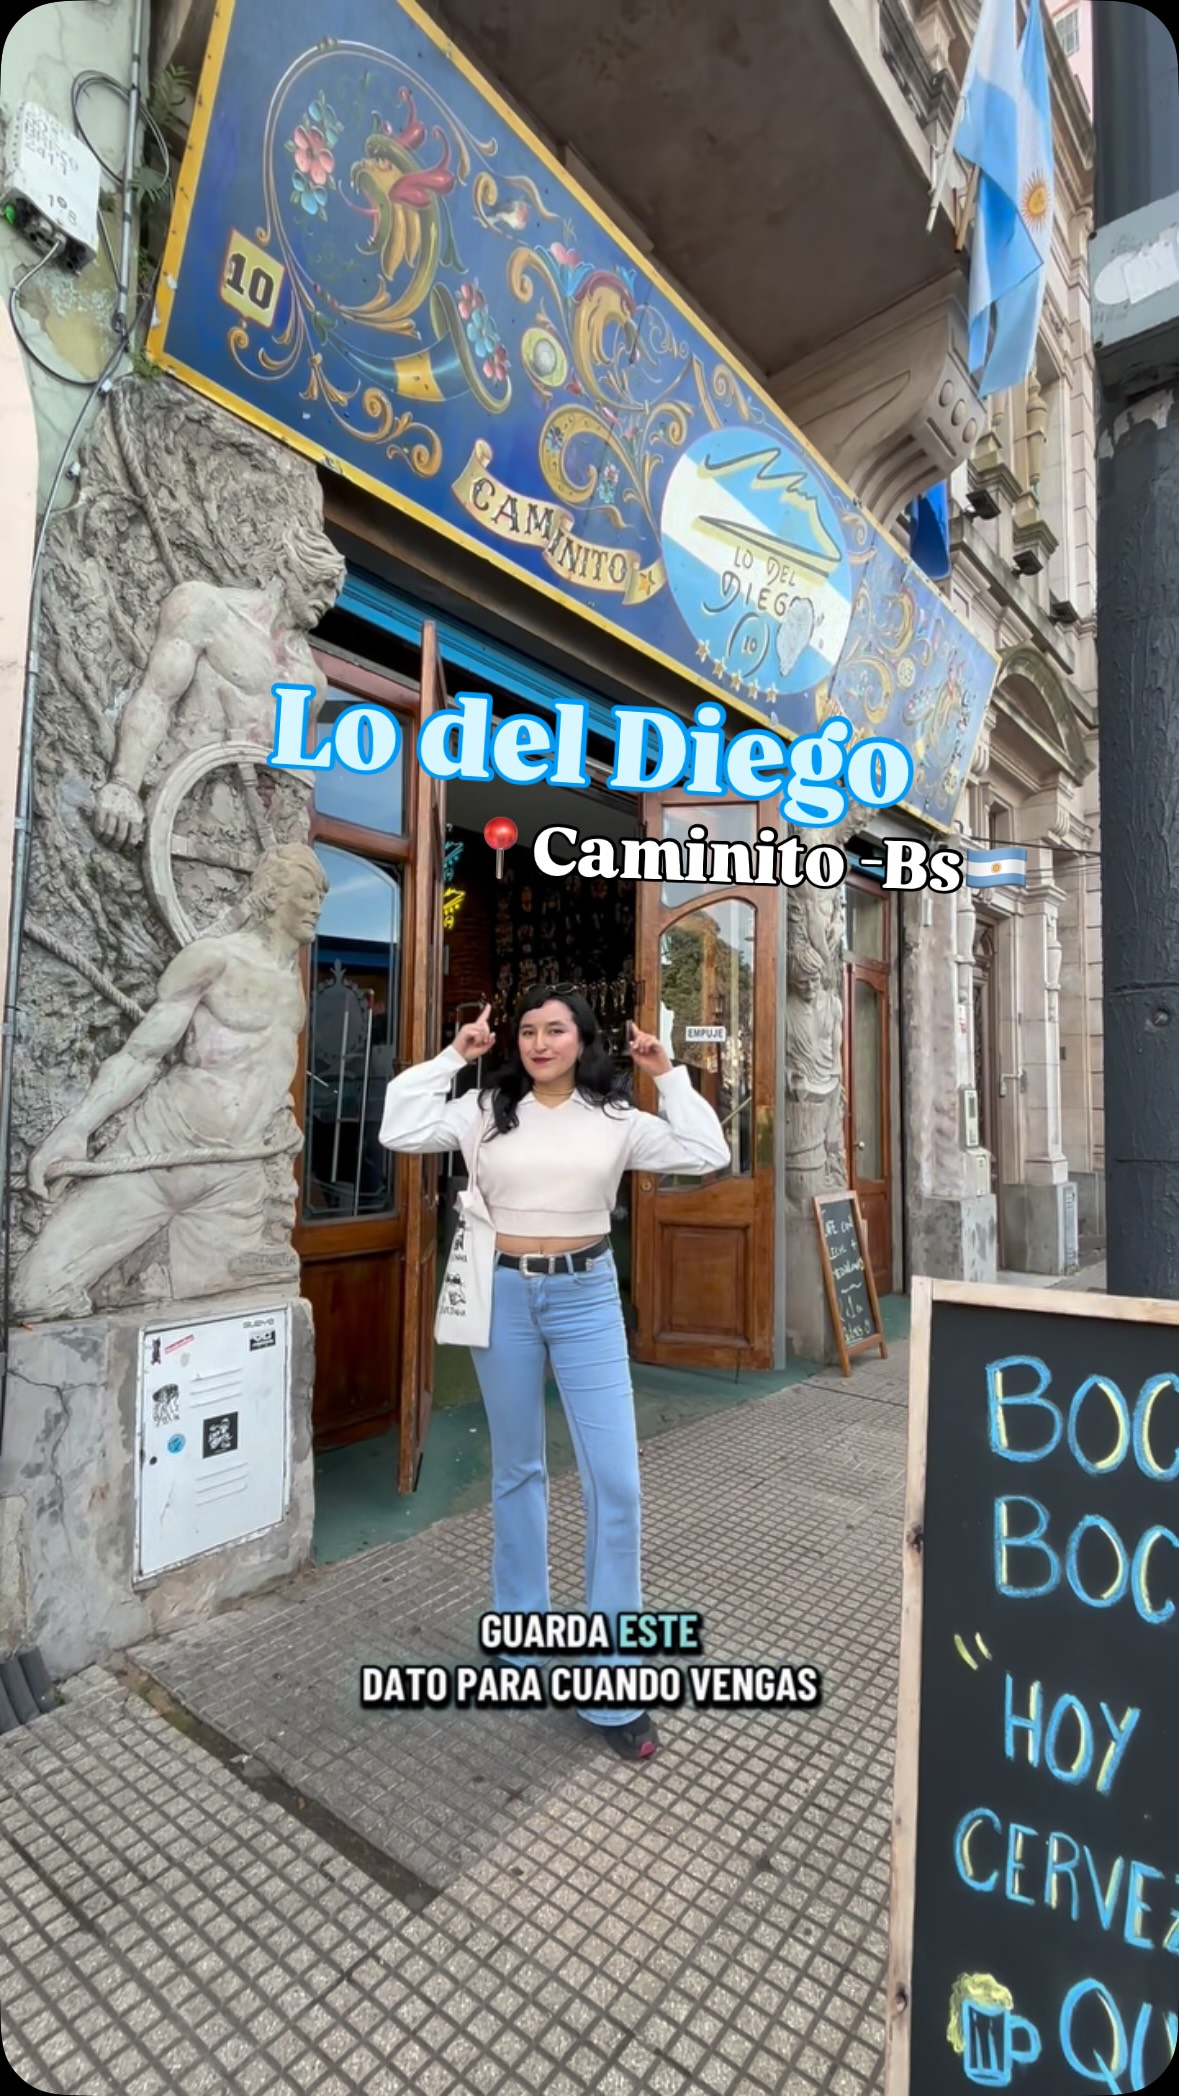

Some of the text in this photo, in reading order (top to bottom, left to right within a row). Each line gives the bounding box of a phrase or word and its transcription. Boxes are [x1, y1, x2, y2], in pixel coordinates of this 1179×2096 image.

[226, 253, 274, 310] 10
[471, 477, 627, 584] CAMINITO
[733, 545, 796, 587] LO DEL
[688, 1028, 723, 1039] EMPUJE
